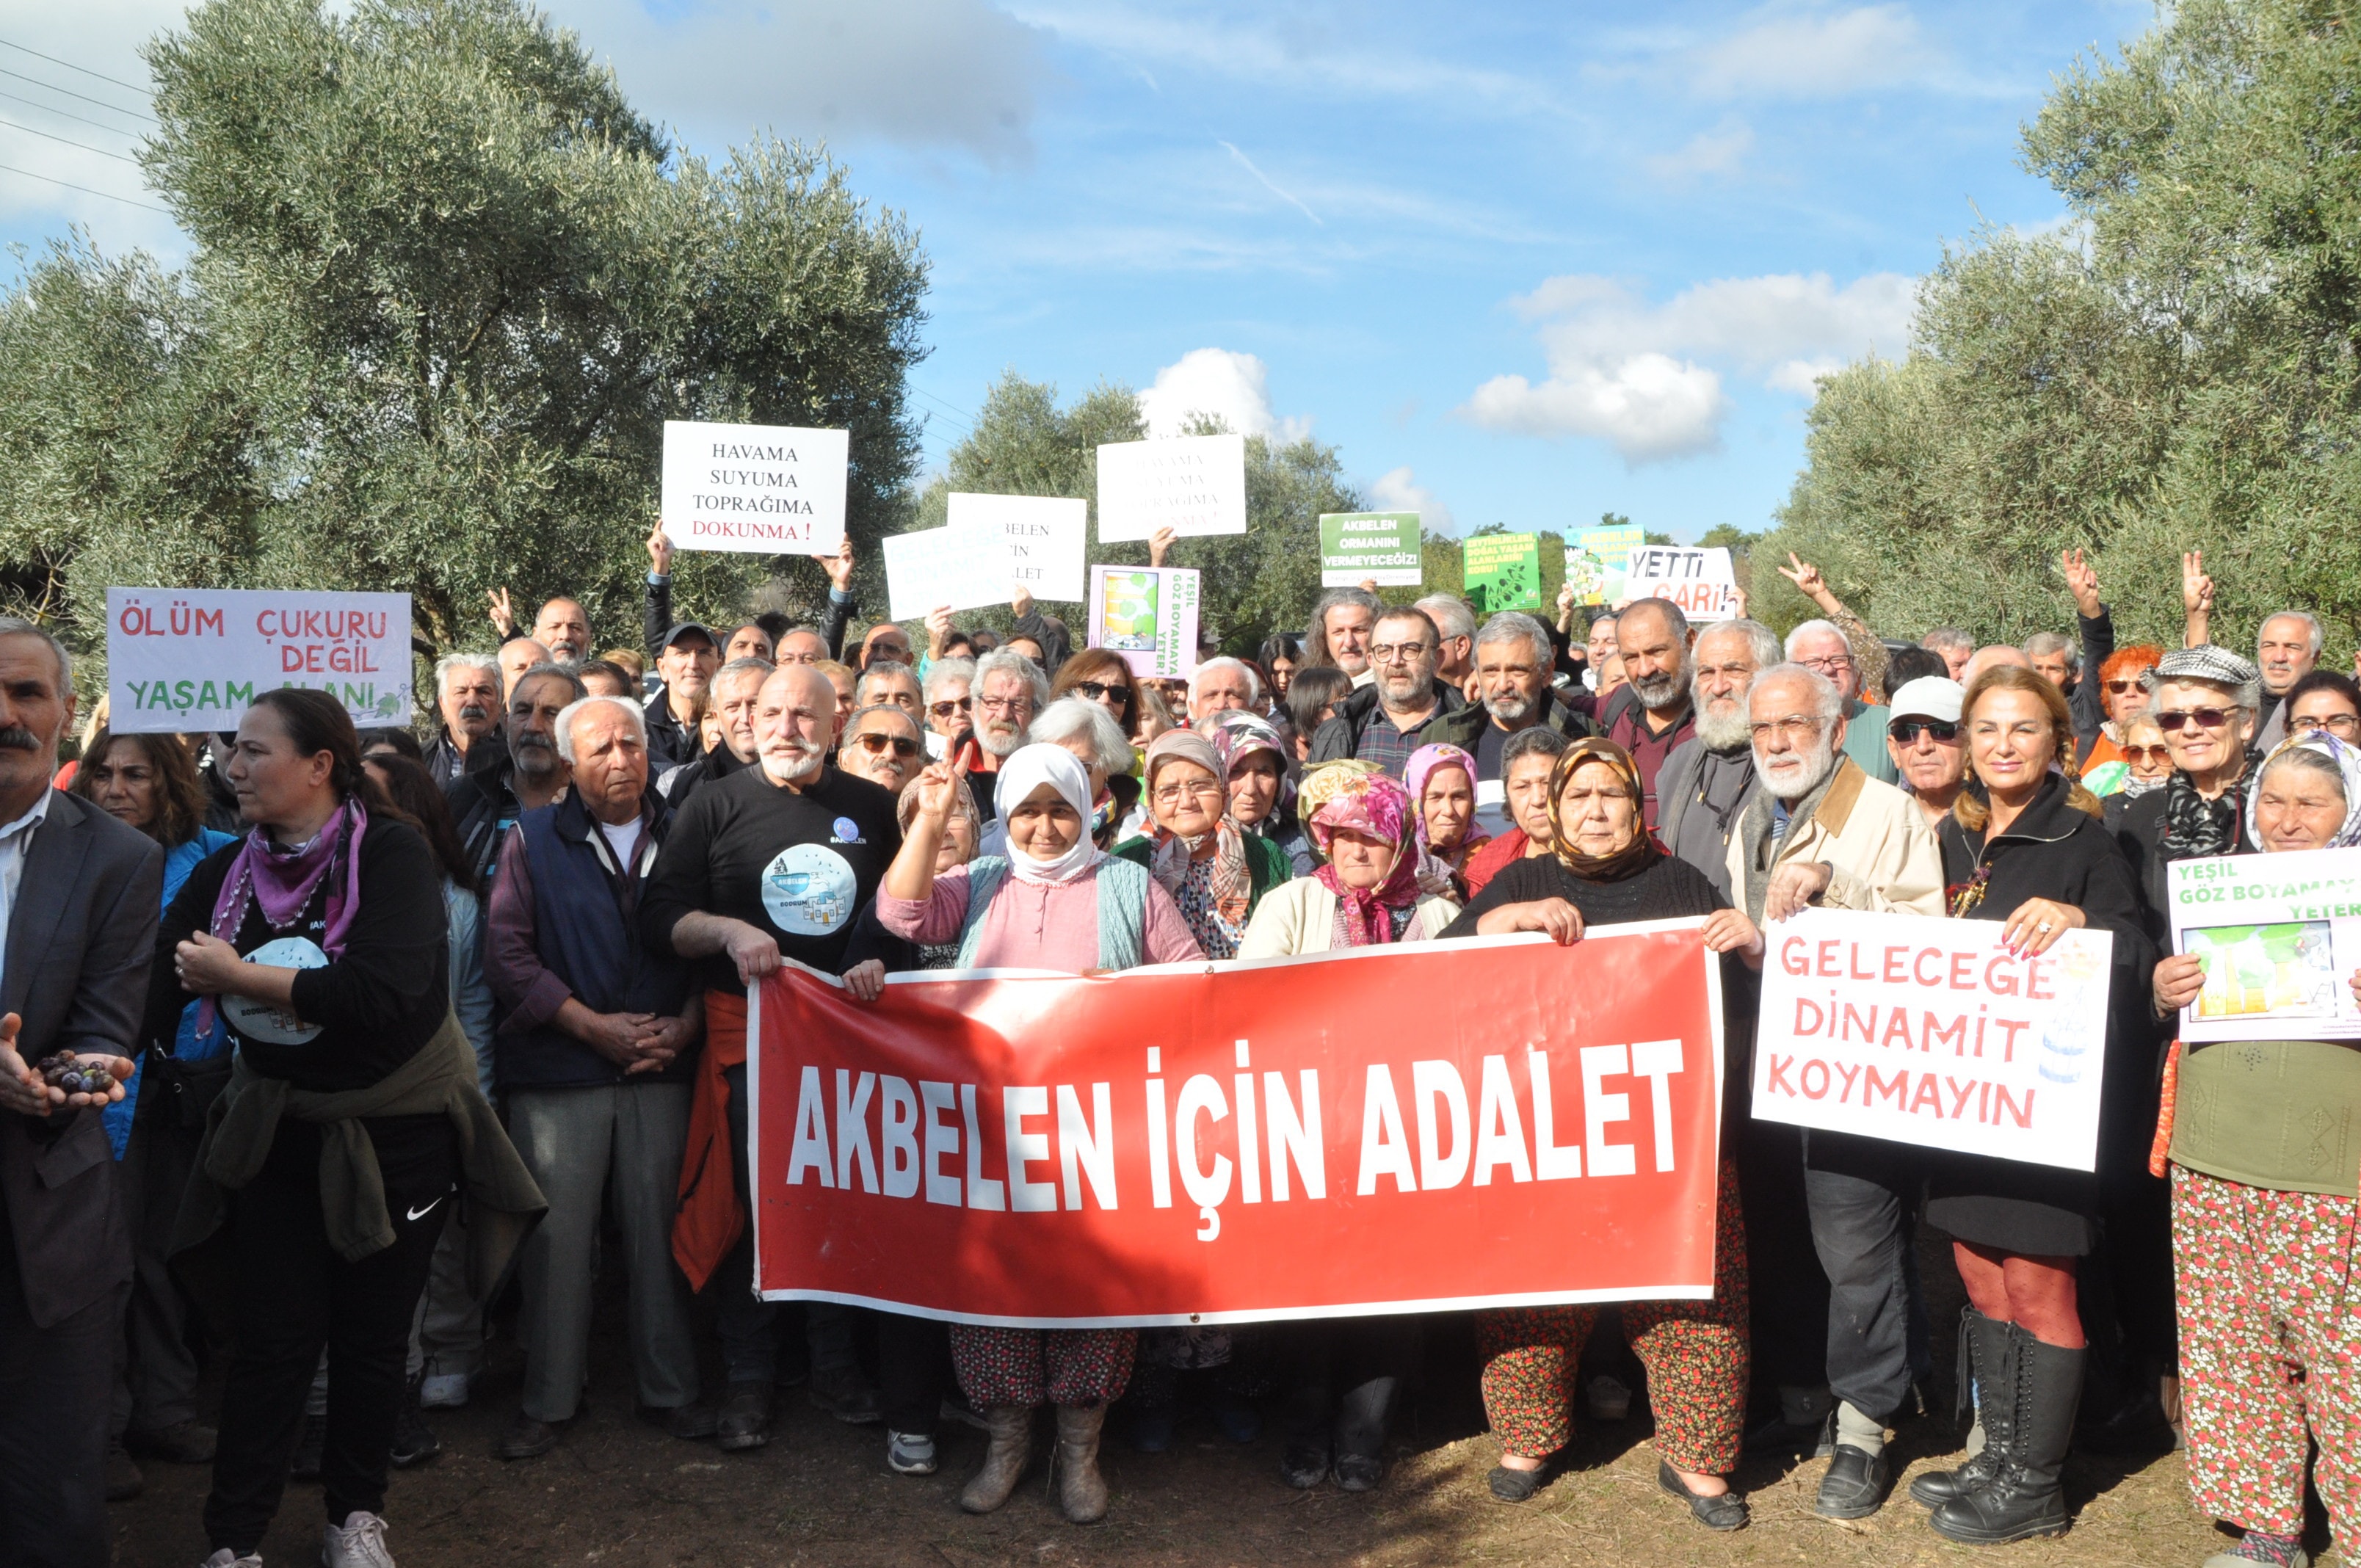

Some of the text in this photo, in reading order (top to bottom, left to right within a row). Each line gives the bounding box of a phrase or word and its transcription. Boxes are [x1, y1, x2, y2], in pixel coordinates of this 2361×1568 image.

[712, 443, 798, 462] HAVAMA
[710, 470, 798, 487] SUYUMA
[693, 495, 813, 514] TOPRAĞIMA
[693, 521, 798, 540] DOKUNMA
[1342, 519, 1397, 531] AKBELEN
[1580, 530, 1643, 544] AKBELEN
[1339, 537, 1400, 549] ORMANINI
[1324, 552, 1418, 567] VERMEYECEĞİZ!
[1185, 575, 1198, 608] YEŞİL
[120, 598, 387, 644] ÖLÜM ÇUKURU
[1169, 574, 1184, 675] GÖZ BOYAMAYA
[282, 638, 380, 674] DEĞİL
[126, 680, 254, 716] YAŞAM
[2177, 858, 2238, 882] YEŞİL
[2179, 884, 2225, 904] GÖZ
[1780, 935, 2056, 1000] GELECEĞE
[1793, 990, 2031, 1062] DİNAMİT
[1767, 1053, 2036, 1128] KOYMAYIN
[786, 1038, 1685, 1242] AKBELEN İÇİN ADALET
